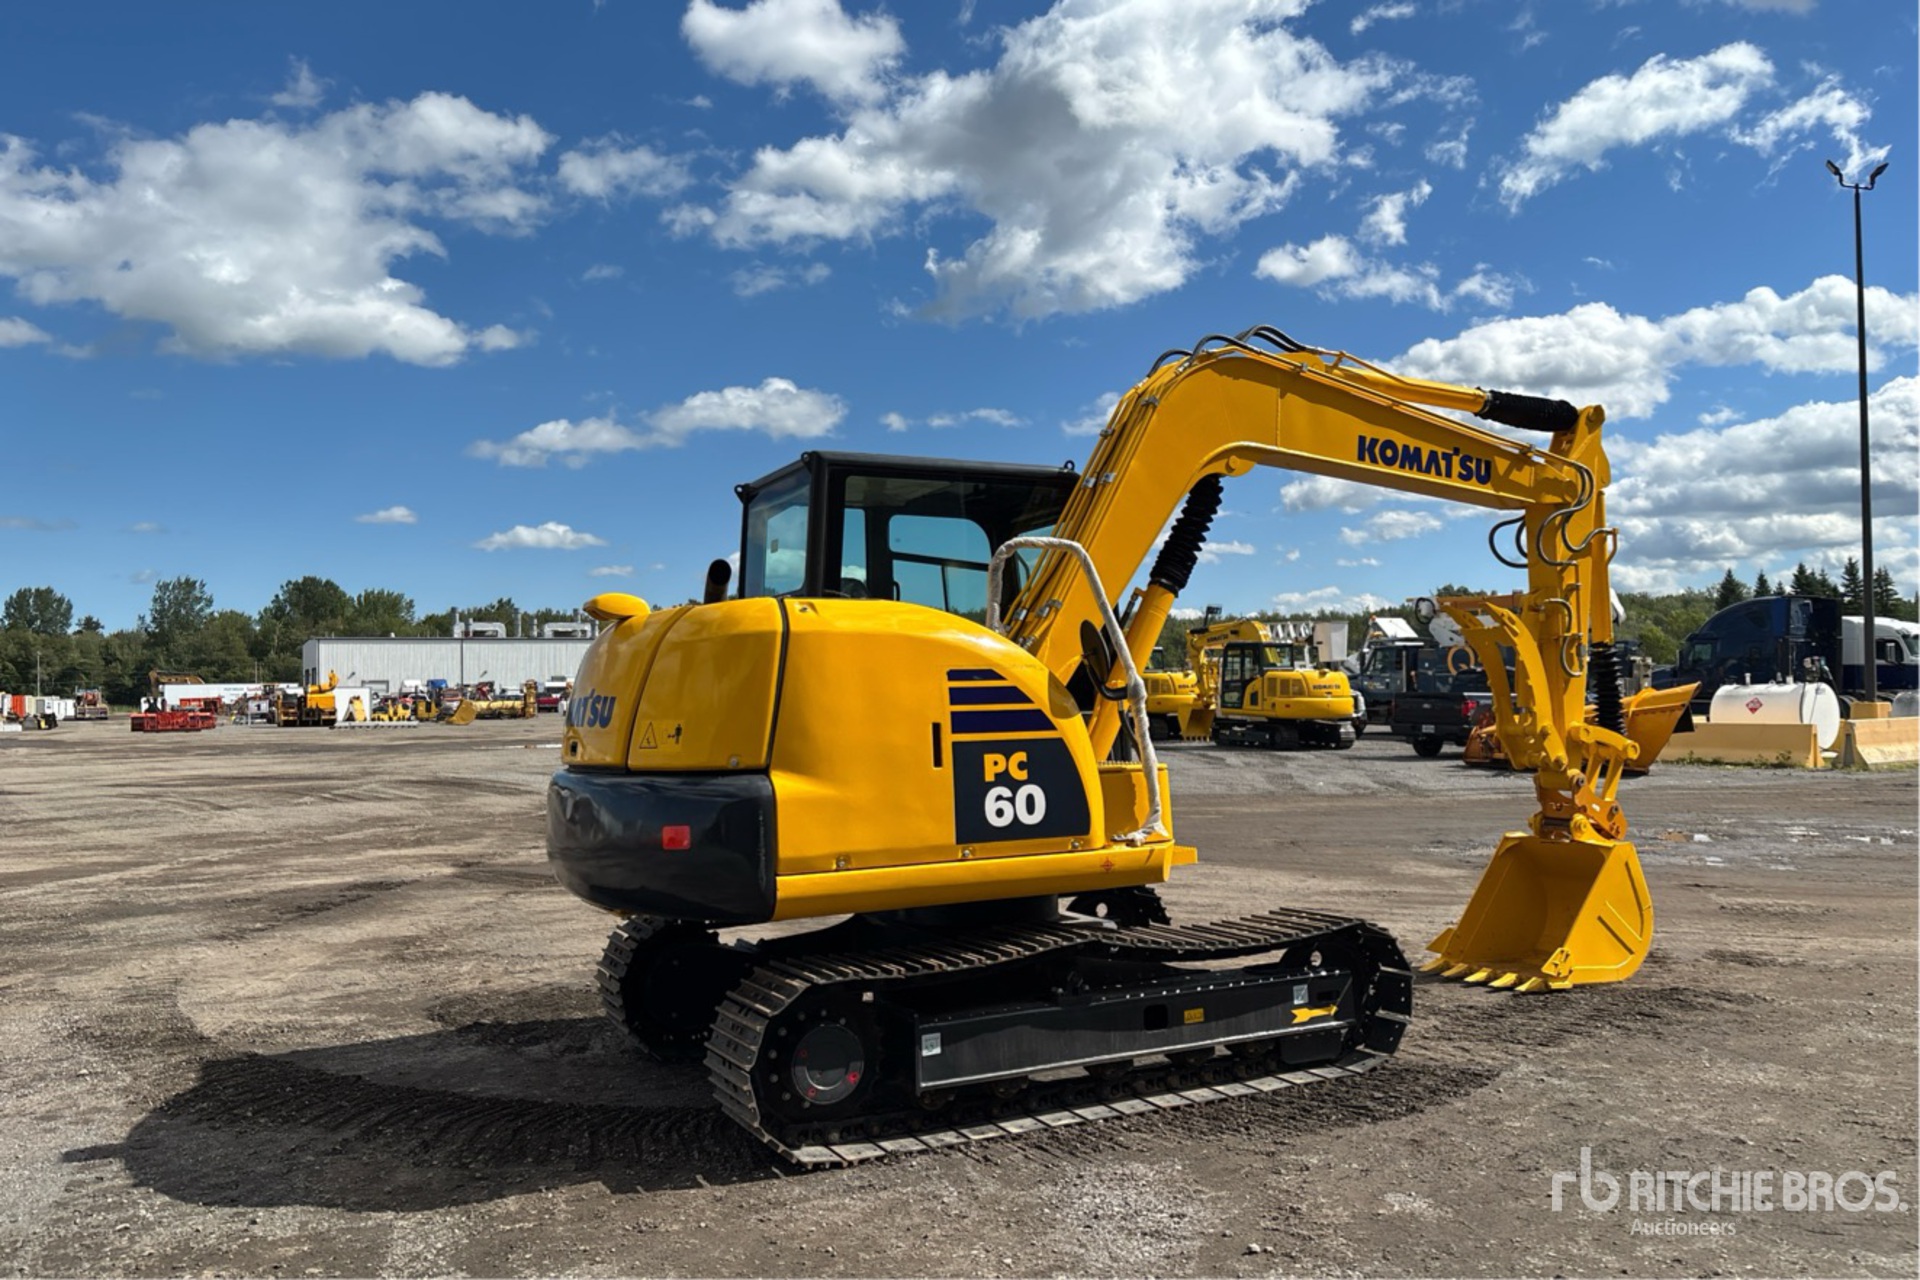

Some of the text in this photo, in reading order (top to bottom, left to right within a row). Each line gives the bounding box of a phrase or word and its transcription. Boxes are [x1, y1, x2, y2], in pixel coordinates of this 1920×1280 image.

[1357, 435, 1491, 485] KOMATSU
[983, 750, 1029, 782] PC
[984, 783, 1047, 828] 60
